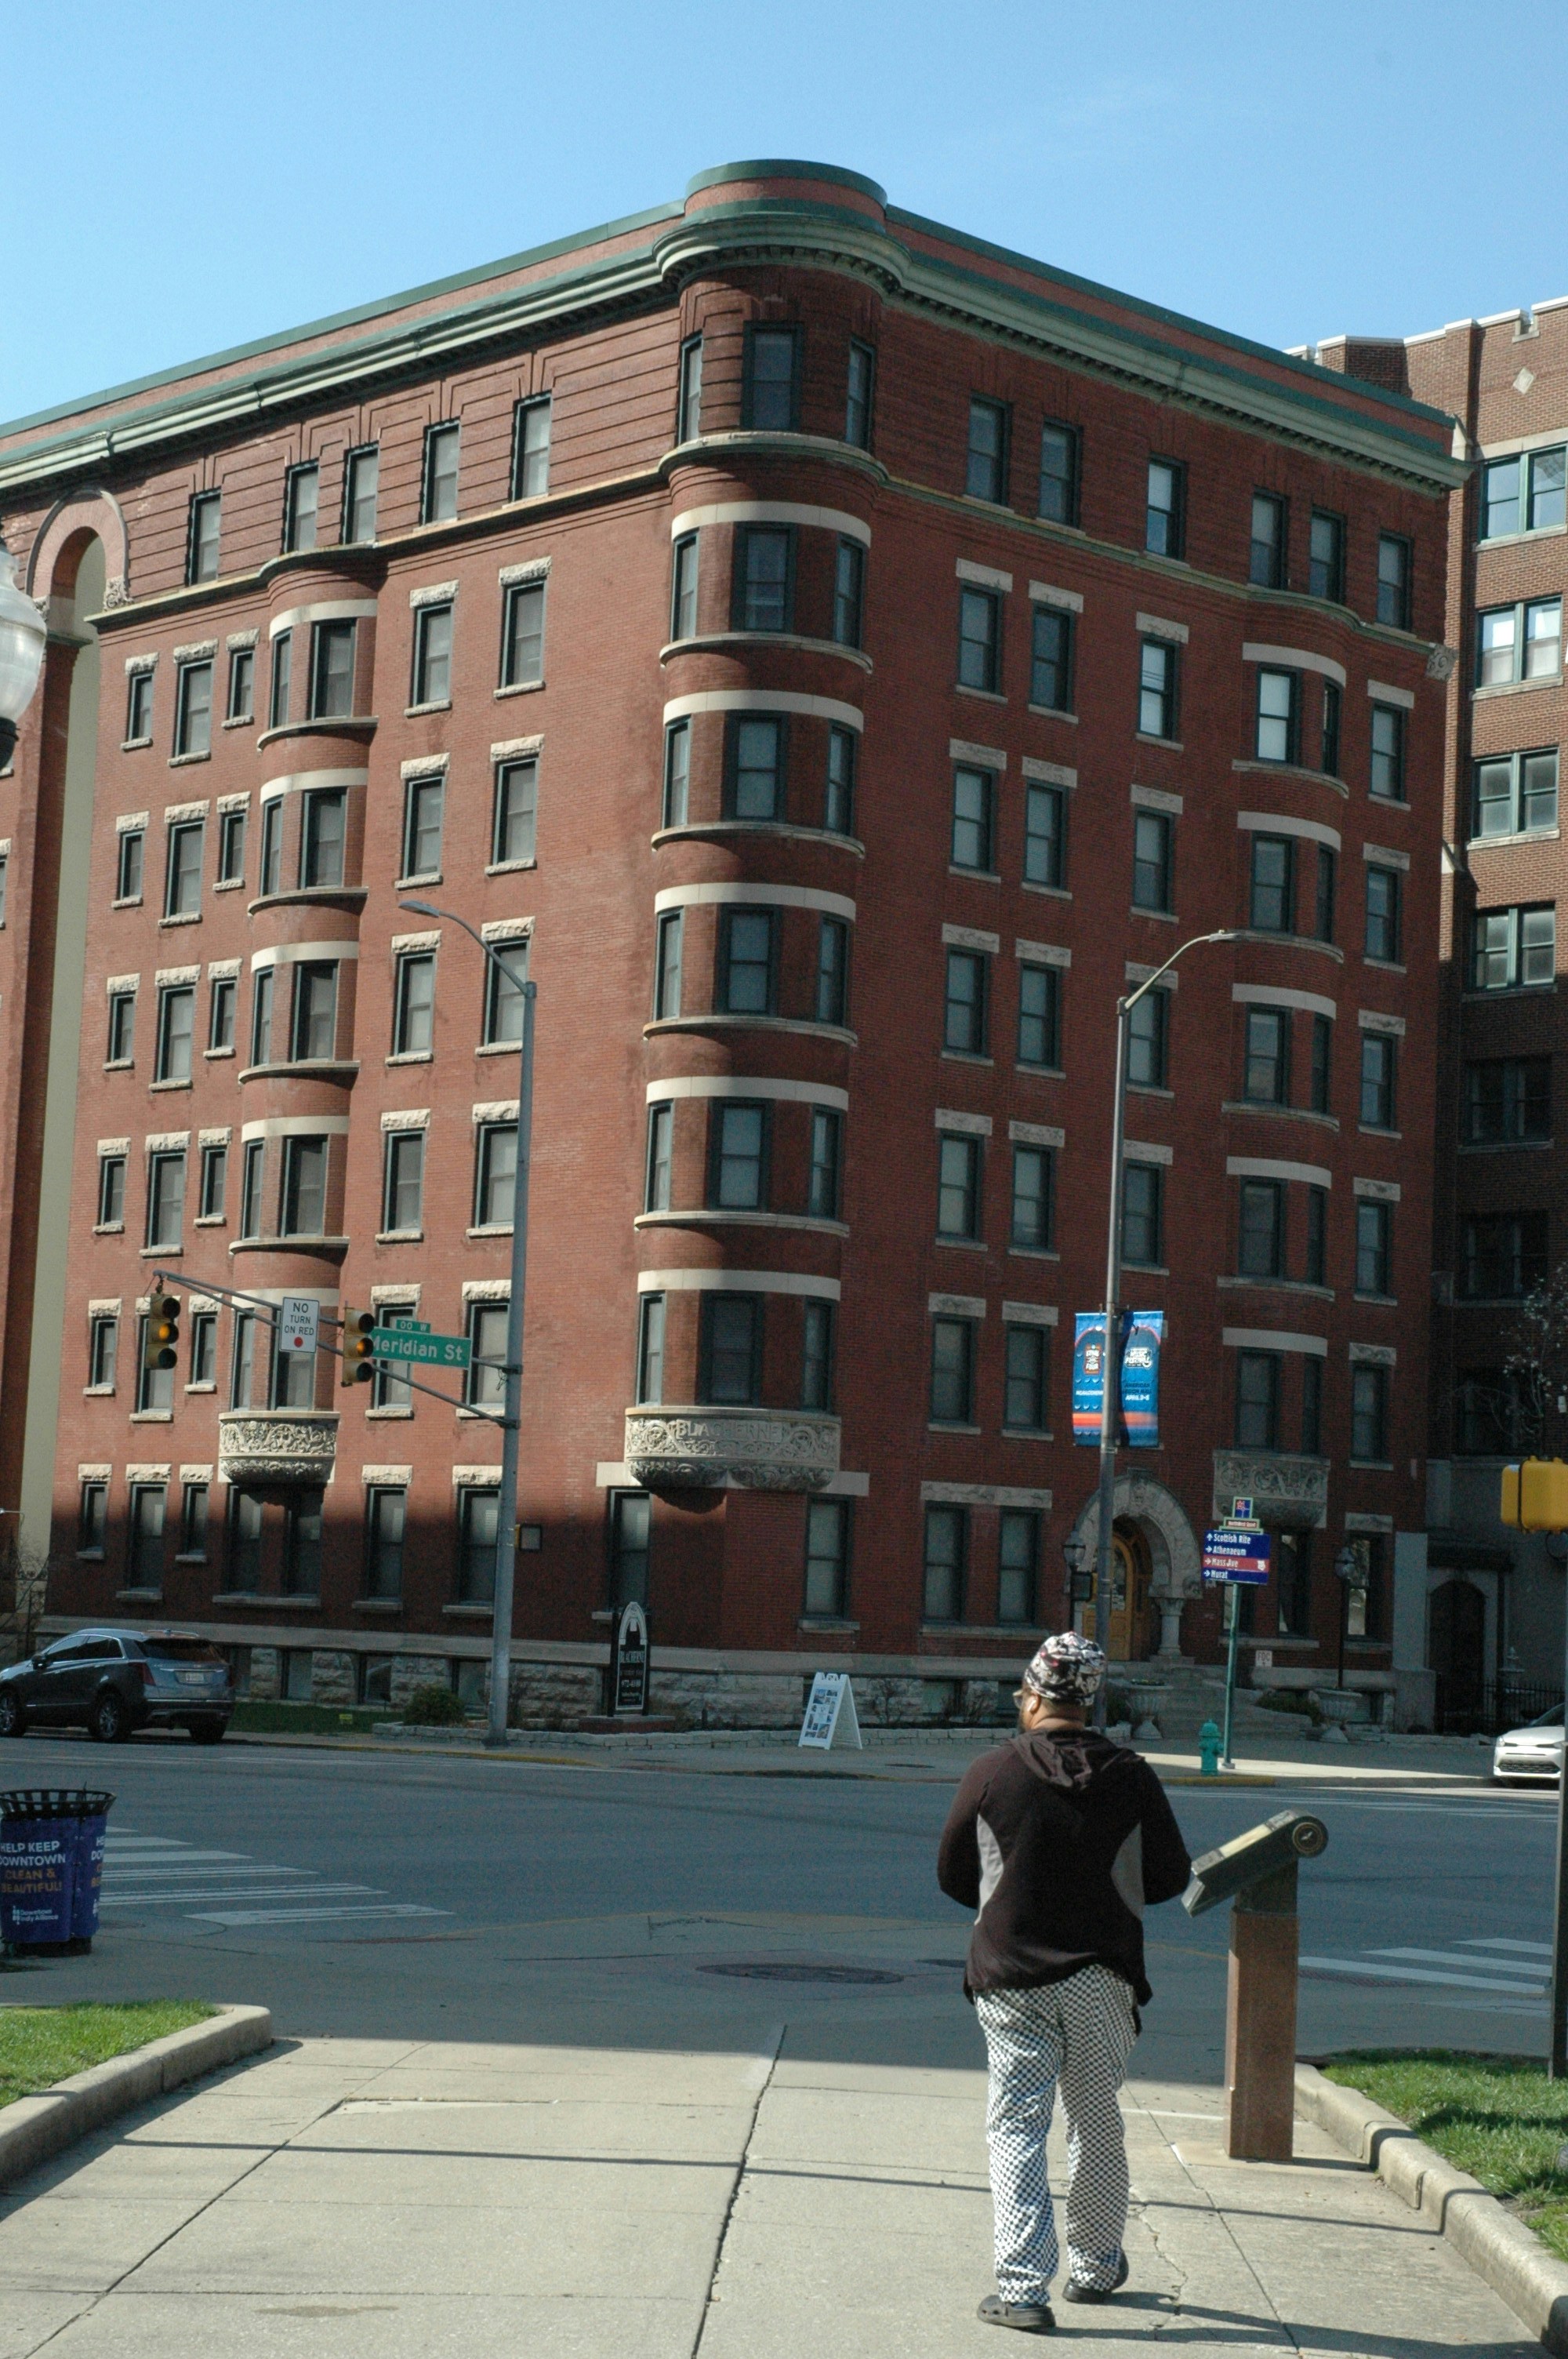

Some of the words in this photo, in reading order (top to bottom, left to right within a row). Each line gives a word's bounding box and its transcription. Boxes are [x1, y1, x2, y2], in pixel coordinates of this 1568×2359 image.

[292, 1302, 309, 1313] NO
[290, 1314, 311, 1324] TURN
[284, 1325, 296, 1333] ON
[299, 1326, 314, 1336] RED
[444, 1344, 463, 1361] St
[1214, 1533, 1237, 1543] Scottish
[1239, 1535, 1251, 1544] Rite
[1212, 1546, 1247, 1556] Athenaeum
[1211, 1558, 1226, 1566] Mass
[1210, 1569, 1229, 1579] Murat
[0, 1842, 25, 1853] HELP
[28, 1841, 60, 1852] KEEP
[5, 1869, 43, 1880] CLEAN
[47, 1868, 56, 1878] &
[0, 1881, 62, 1893] BEAUTIFUL!
